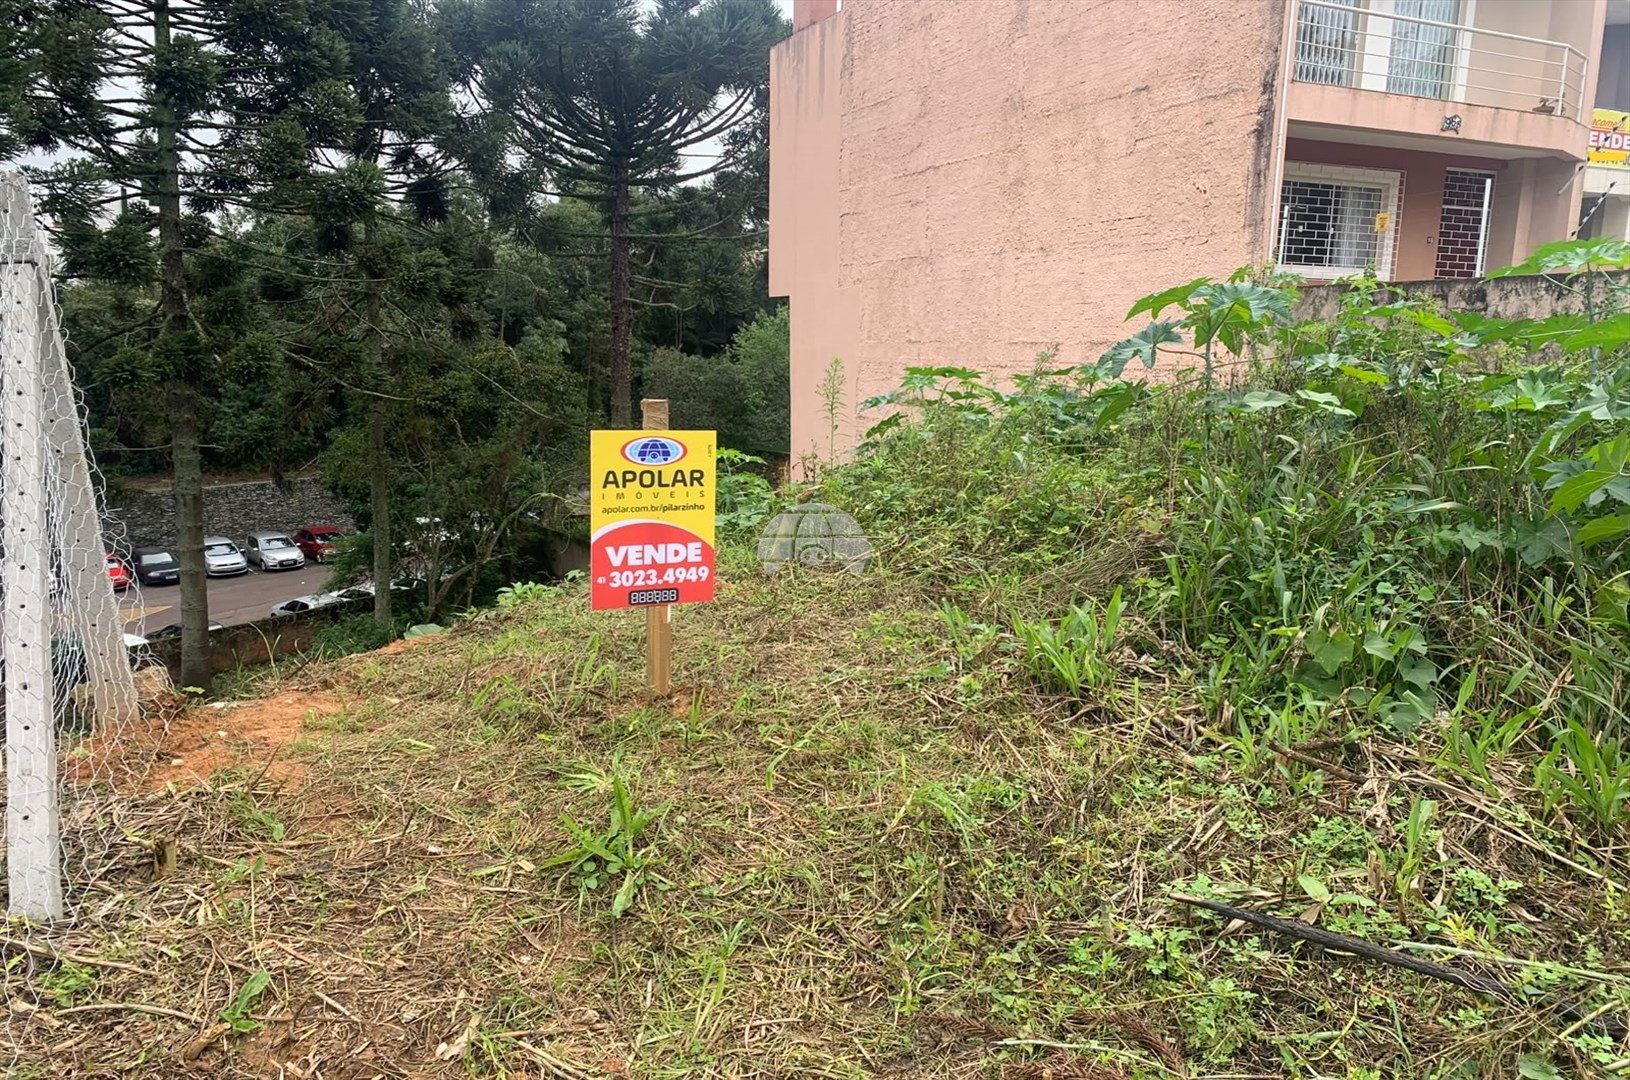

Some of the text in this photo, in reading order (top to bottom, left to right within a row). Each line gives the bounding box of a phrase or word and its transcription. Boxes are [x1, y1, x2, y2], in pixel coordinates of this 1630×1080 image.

[602, 469, 705, 489] APOLAR
[602, 503, 705, 515] apolar.com.br/pilarzinho
[605, 541, 702, 567] VENDE
[596, 566, 709, 588] 41 3023.4949
